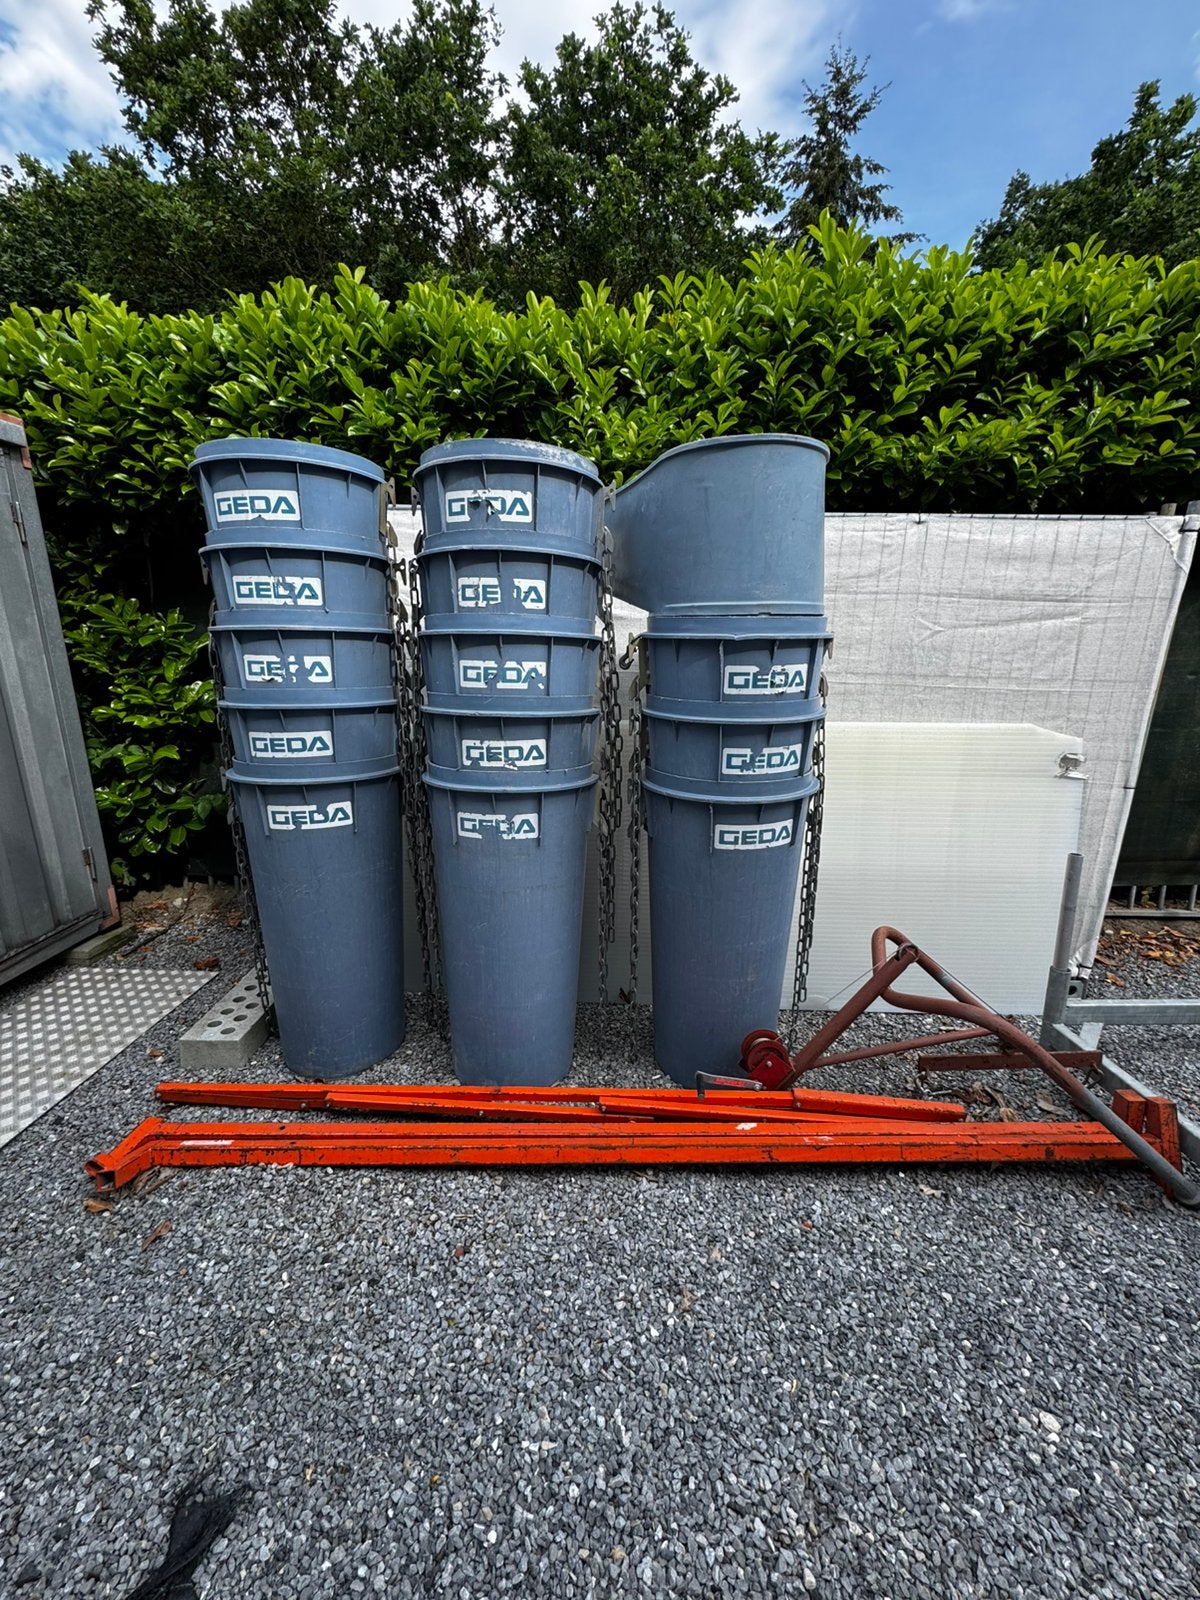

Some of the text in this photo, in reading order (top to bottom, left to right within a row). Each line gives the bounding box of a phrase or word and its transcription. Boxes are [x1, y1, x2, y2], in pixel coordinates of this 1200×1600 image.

[216, 496, 296, 516] GEDA
[447, 497, 530, 517] GDA
[247, 661, 329, 677] GEA
[728, 671, 804, 689] GEDA
[251, 736, 330, 753] GEDA
[465, 745, 544, 762] GEDA
[719, 825, 791, 845] GEDA
